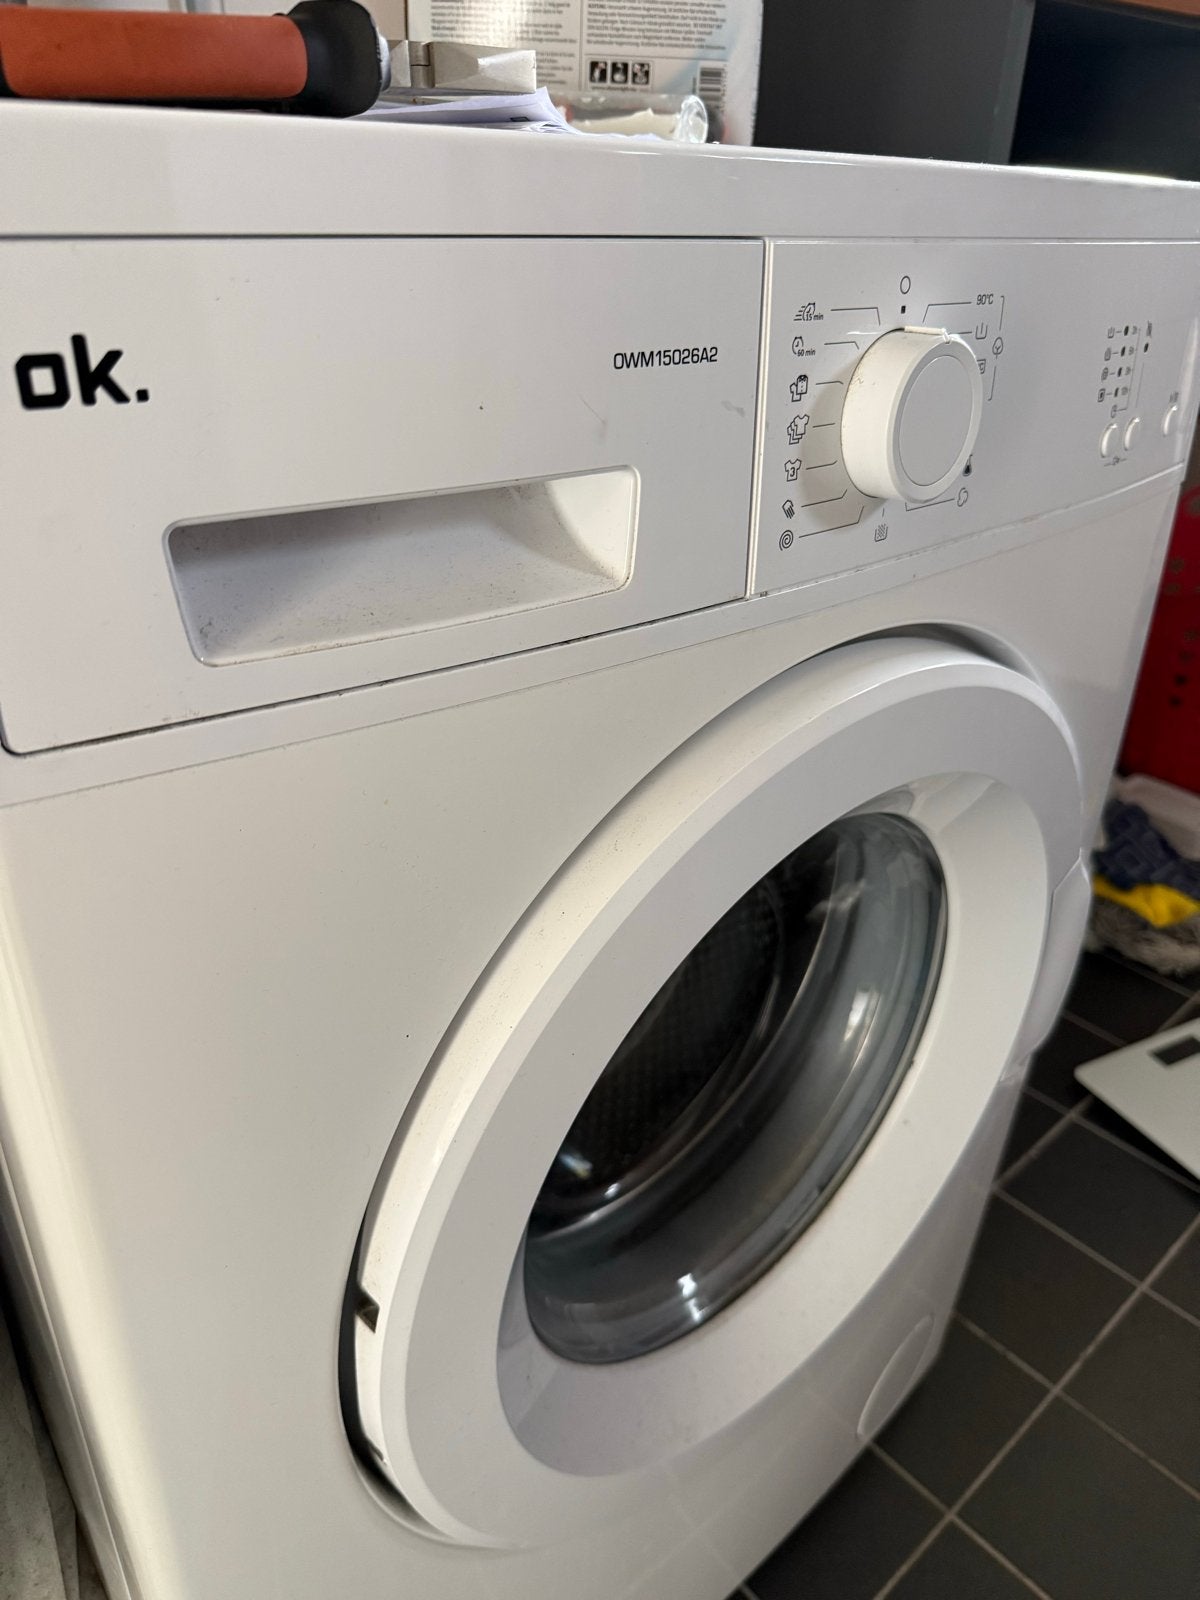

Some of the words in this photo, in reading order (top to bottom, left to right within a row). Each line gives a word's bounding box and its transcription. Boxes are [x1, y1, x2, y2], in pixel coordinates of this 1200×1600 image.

[976, 293, 994, 305] 90°C
[805, 313, 813, 322] 15
[813, 312, 825, 321] min
[613, 346, 719, 370] OWM15026A2
[805, 348, 816, 356] min
[15, 333, 150, 410] ok.
